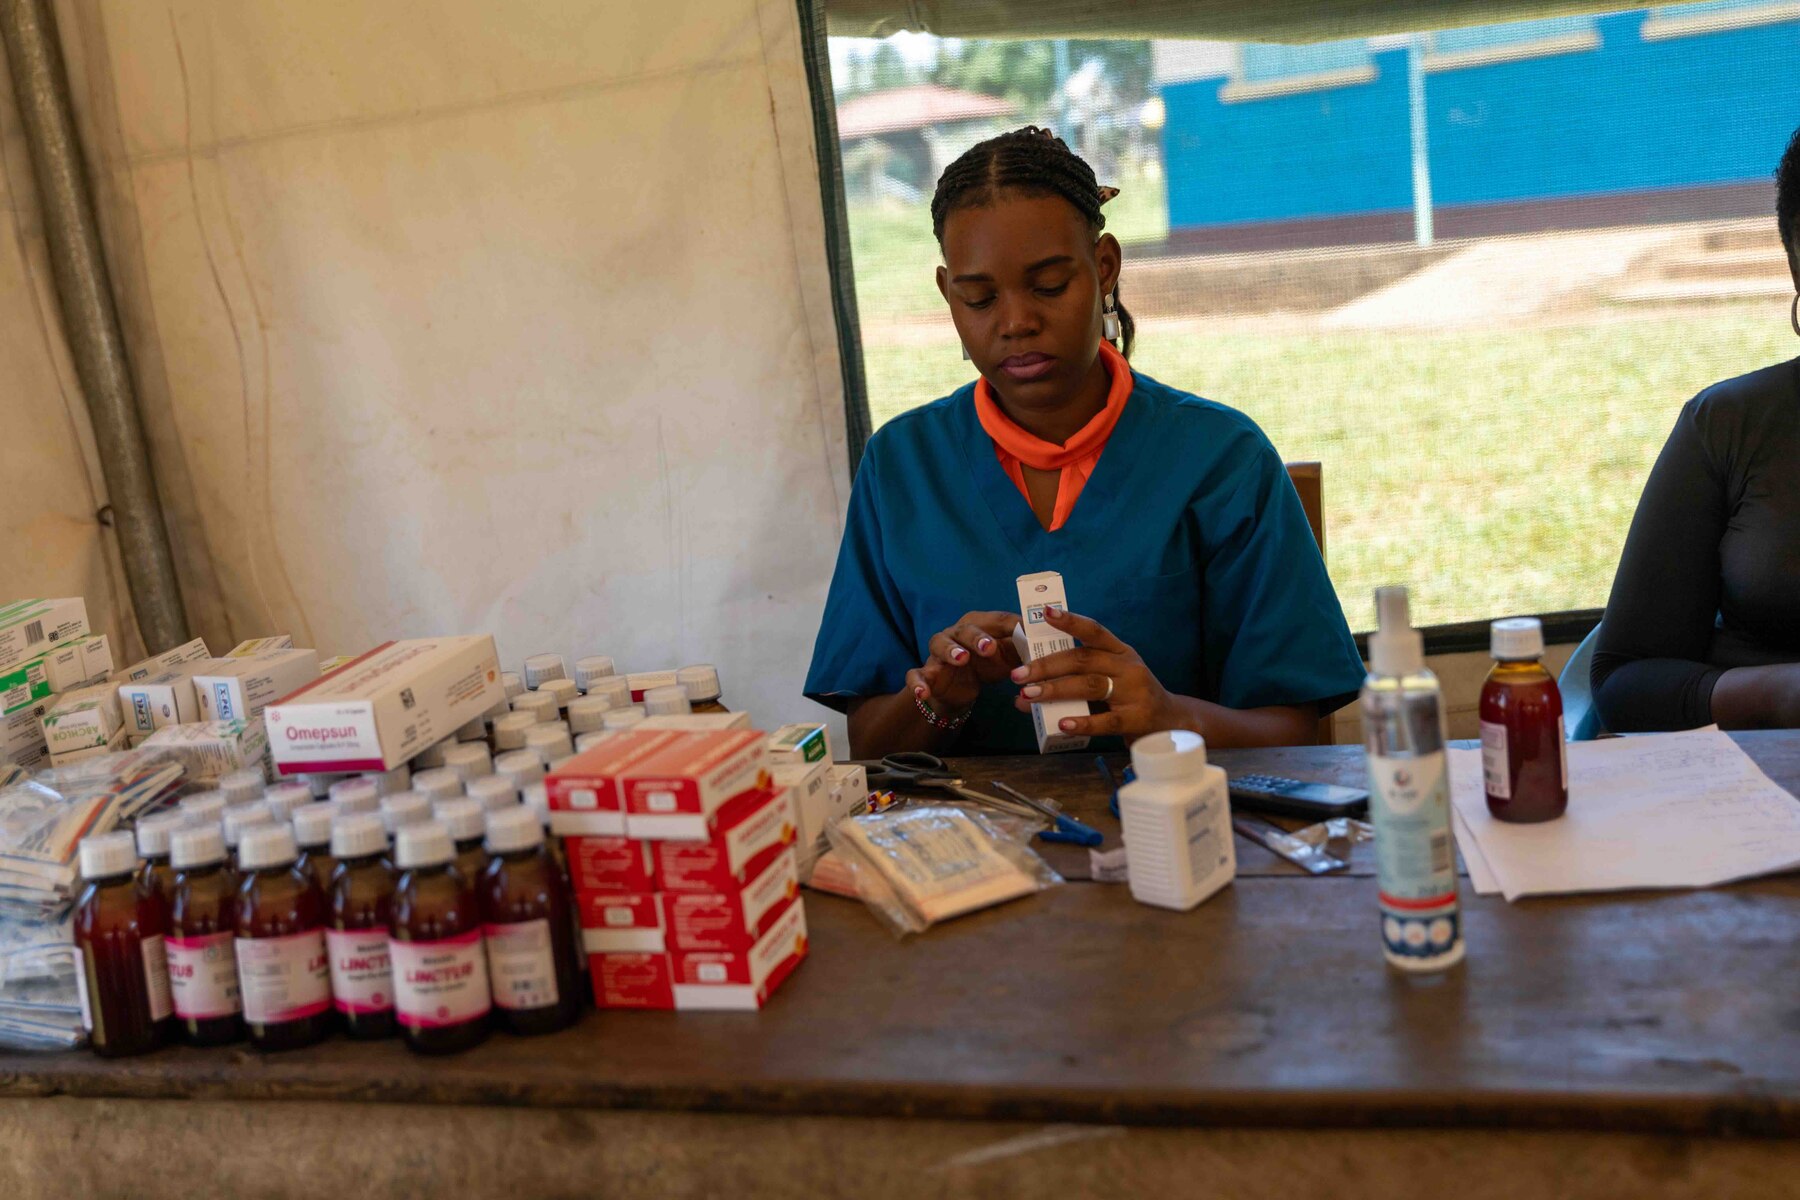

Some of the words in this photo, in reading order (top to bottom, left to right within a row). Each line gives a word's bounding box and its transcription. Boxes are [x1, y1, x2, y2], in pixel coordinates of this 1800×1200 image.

[136, 698, 148, 726] X-PEL
[220, 688, 230, 717] X-PEL
[52, 726, 99, 742] ABCHLOR
[286, 725, 358, 743] Omepsun
[341, 952, 391, 971] LINCT
